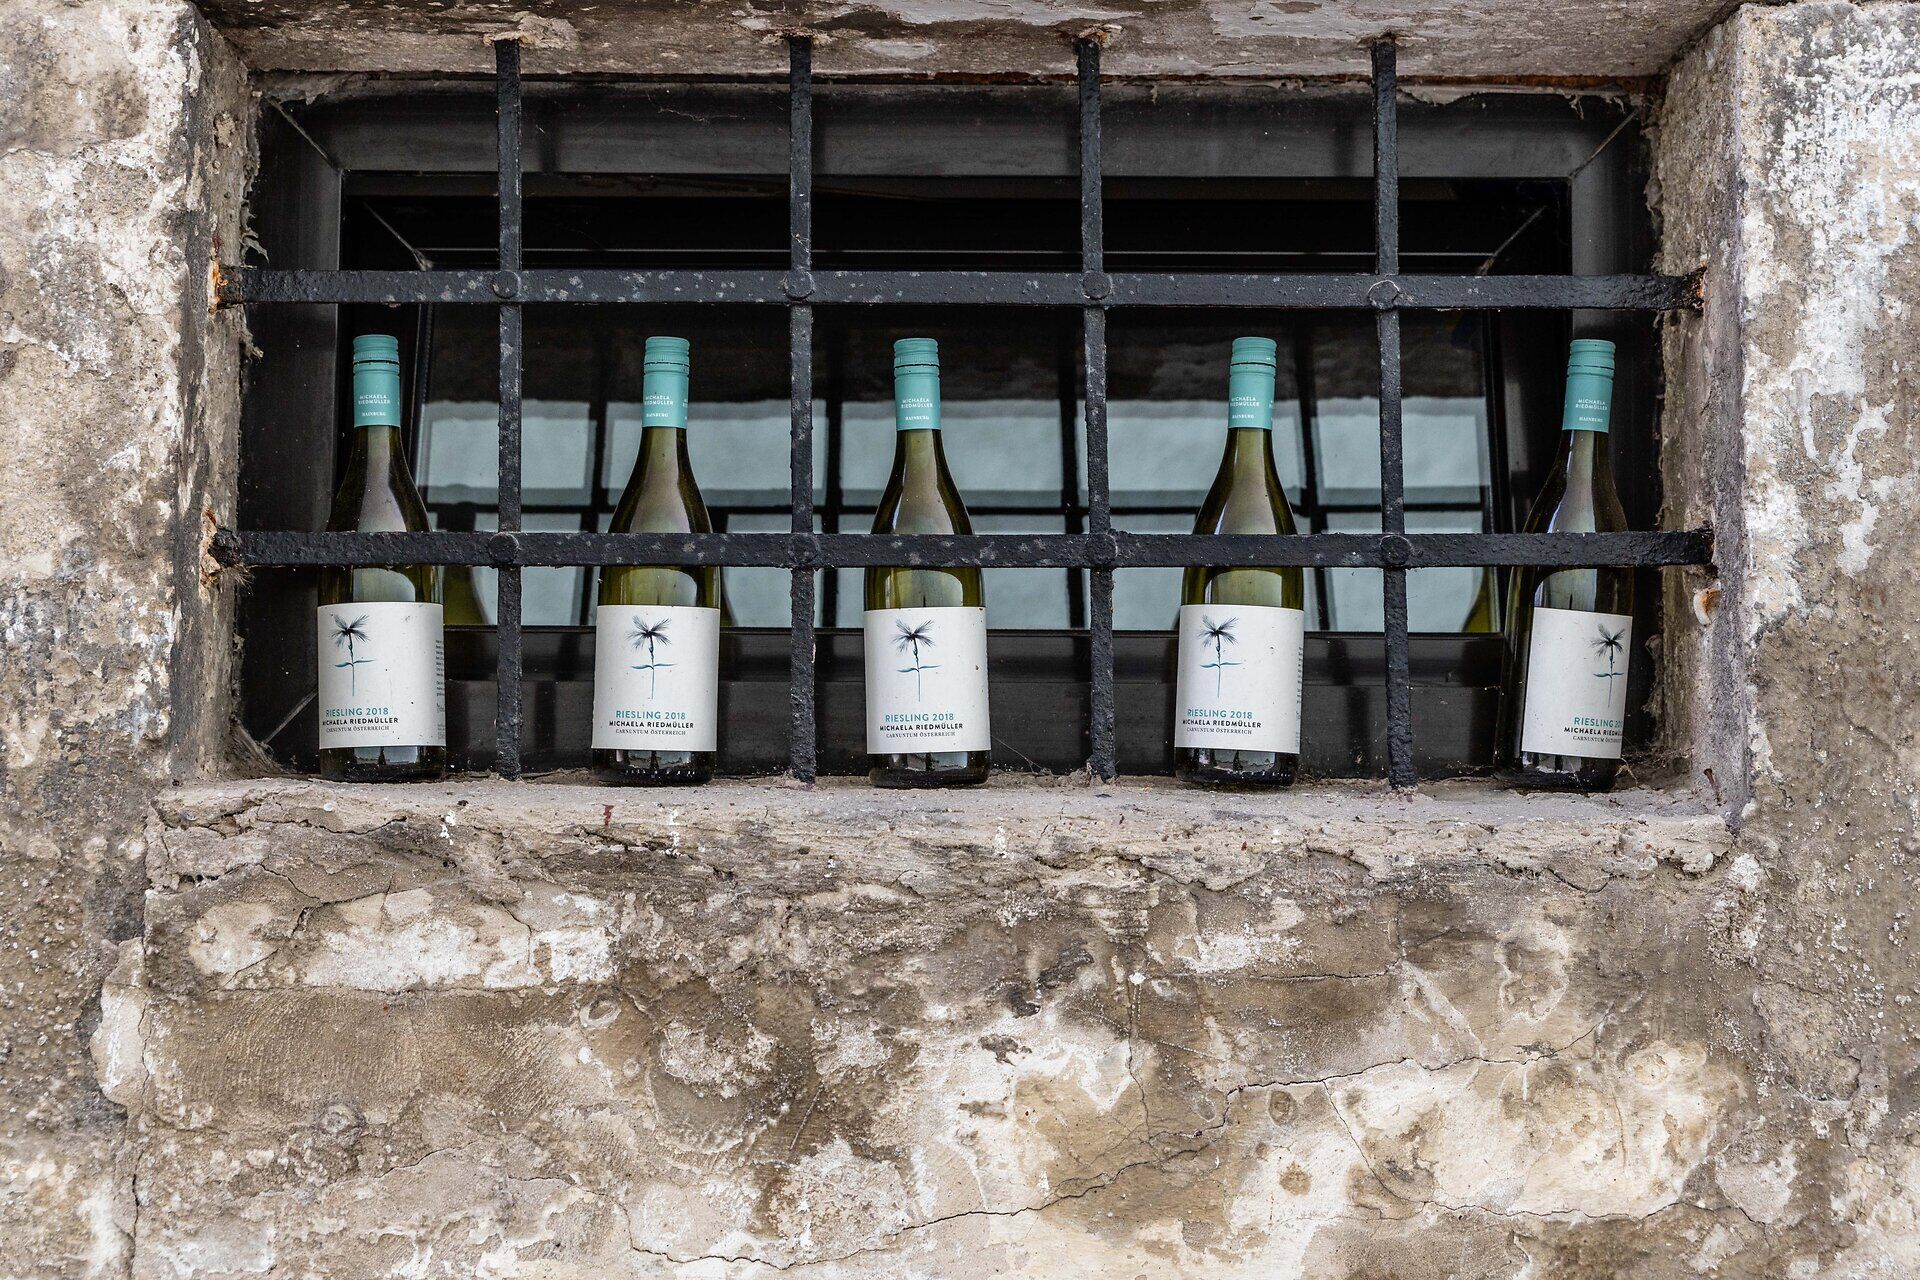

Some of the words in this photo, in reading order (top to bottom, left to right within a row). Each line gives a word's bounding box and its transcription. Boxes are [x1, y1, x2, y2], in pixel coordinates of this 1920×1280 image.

[325, 708, 363, 717] RIESLING
[366, 707, 389, 715] 2018
[615, 710, 661, 720] RIESLING
[664, 712, 686, 720] 2018
[1187, 708, 1227, 718] RIESLING
[1230, 711, 1253, 719] 2018
[349, 717, 399, 725] RIEDMÜLLER
[885, 713, 929, 723] RIESLING
[932, 713, 954, 721] 2018
[1573, 717, 1614, 727] RIESLING
[647, 721, 694, 729] RIEDMÜLLER
[1212, 719, 1261, 728] RIEDMÜLLER
[650, 728, 686, 736] ÖSTERREICH
[1216, 727, 1252, 735] ÖSTERREICH
[1564, 727, 1601, 735] MICHAELA
